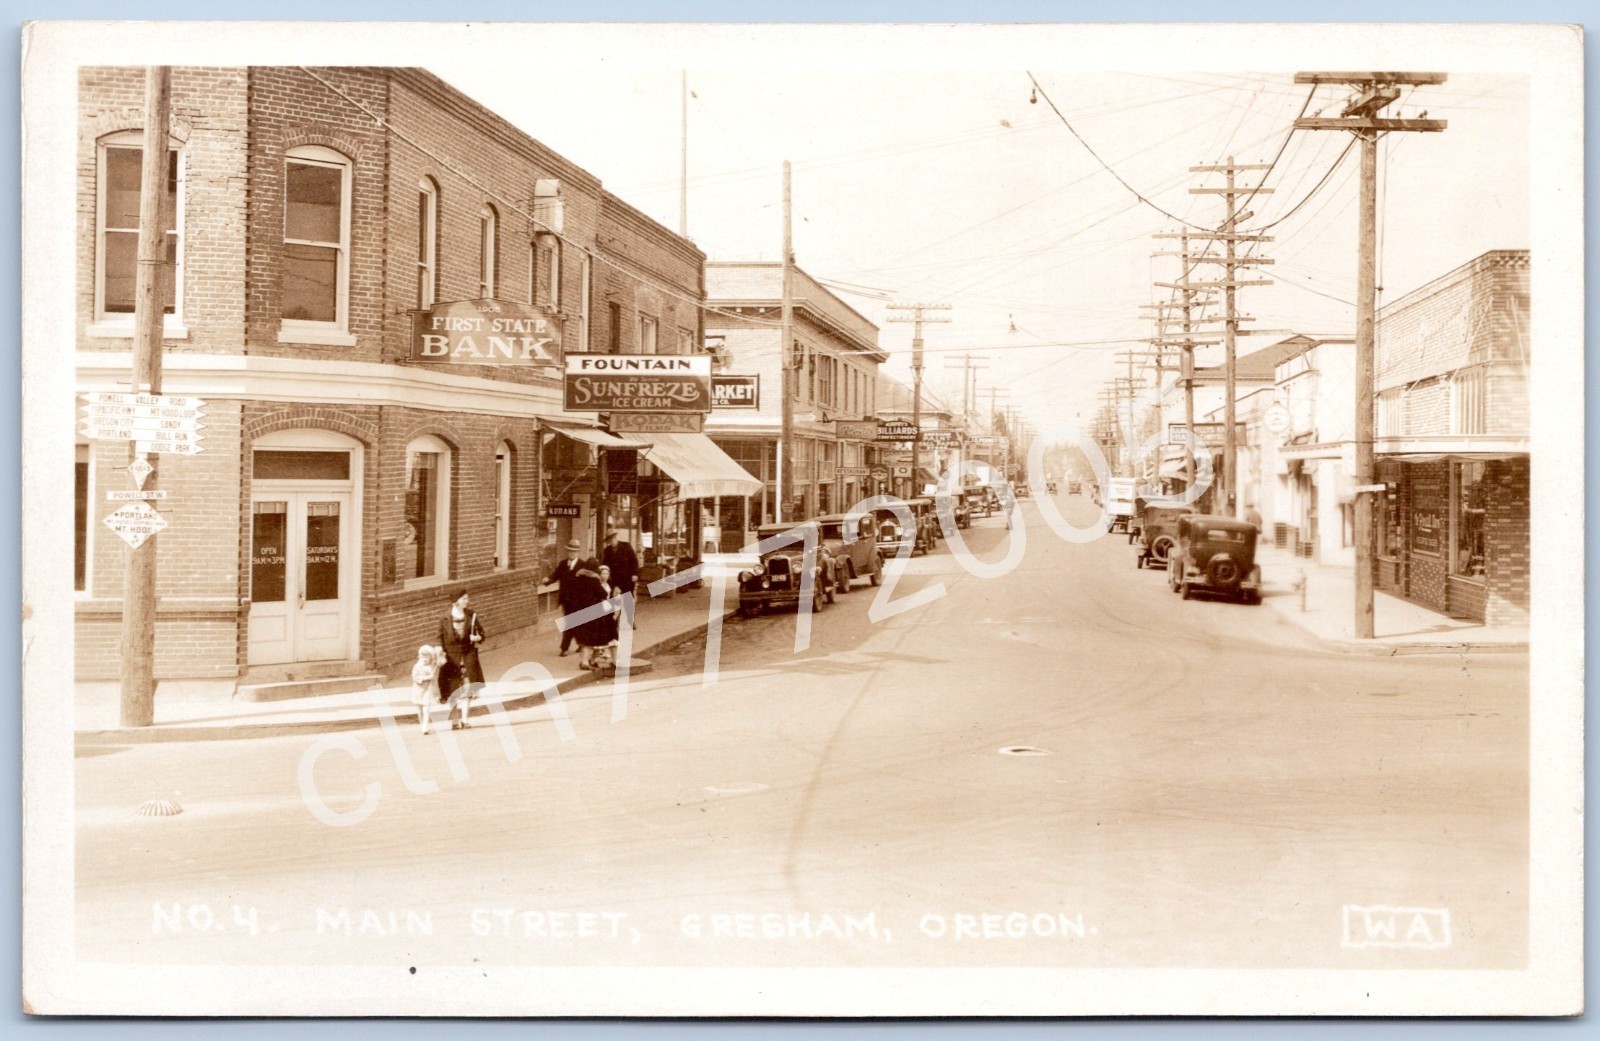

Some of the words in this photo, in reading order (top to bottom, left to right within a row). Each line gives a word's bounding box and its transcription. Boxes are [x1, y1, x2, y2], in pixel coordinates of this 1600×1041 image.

[431, 316, 485, 332] FIRST
[491, 318, 547, 333] STATE
[420, 334, 554, 360] BANK
[581, 359, 692, 370] FOUNTAIN
[574, 377, 700, 404] SUNFREZE
[98, 394, 124, 403] POWELL
[135, 396, 160, 405] VALLEY
[170, 397, 187, 406] ROAD
[612, 397, 630, 408] ICE
[632, 397, 672, 408] CREAM
[97, 406, 121, 414] PACIFIC
[161, 409, 179, 417] HOOD
[179, 410, 196, 418] LOOP
[93, 418, 119, 426] OREGON
[160, 420, 182, 429] SANDY
[614, 415, 697, 431] KODAK
[97, 429, 132, 438] PORTLAND
[155, 431, 172, 440] BULL
[174, 432, 188, 441] RUN
[877, 426, 918, 435] BILLIARDS
[150, 443, 171, 452] DODGE
[175, 444, 190, 452] PARK
[120, 511, 157, 520] PORTLAND
[130, 526, 153, 534] HOOD
[260, 547, 277, 555] OPEN
[306, 546, 338, 554] SATURDAYS
